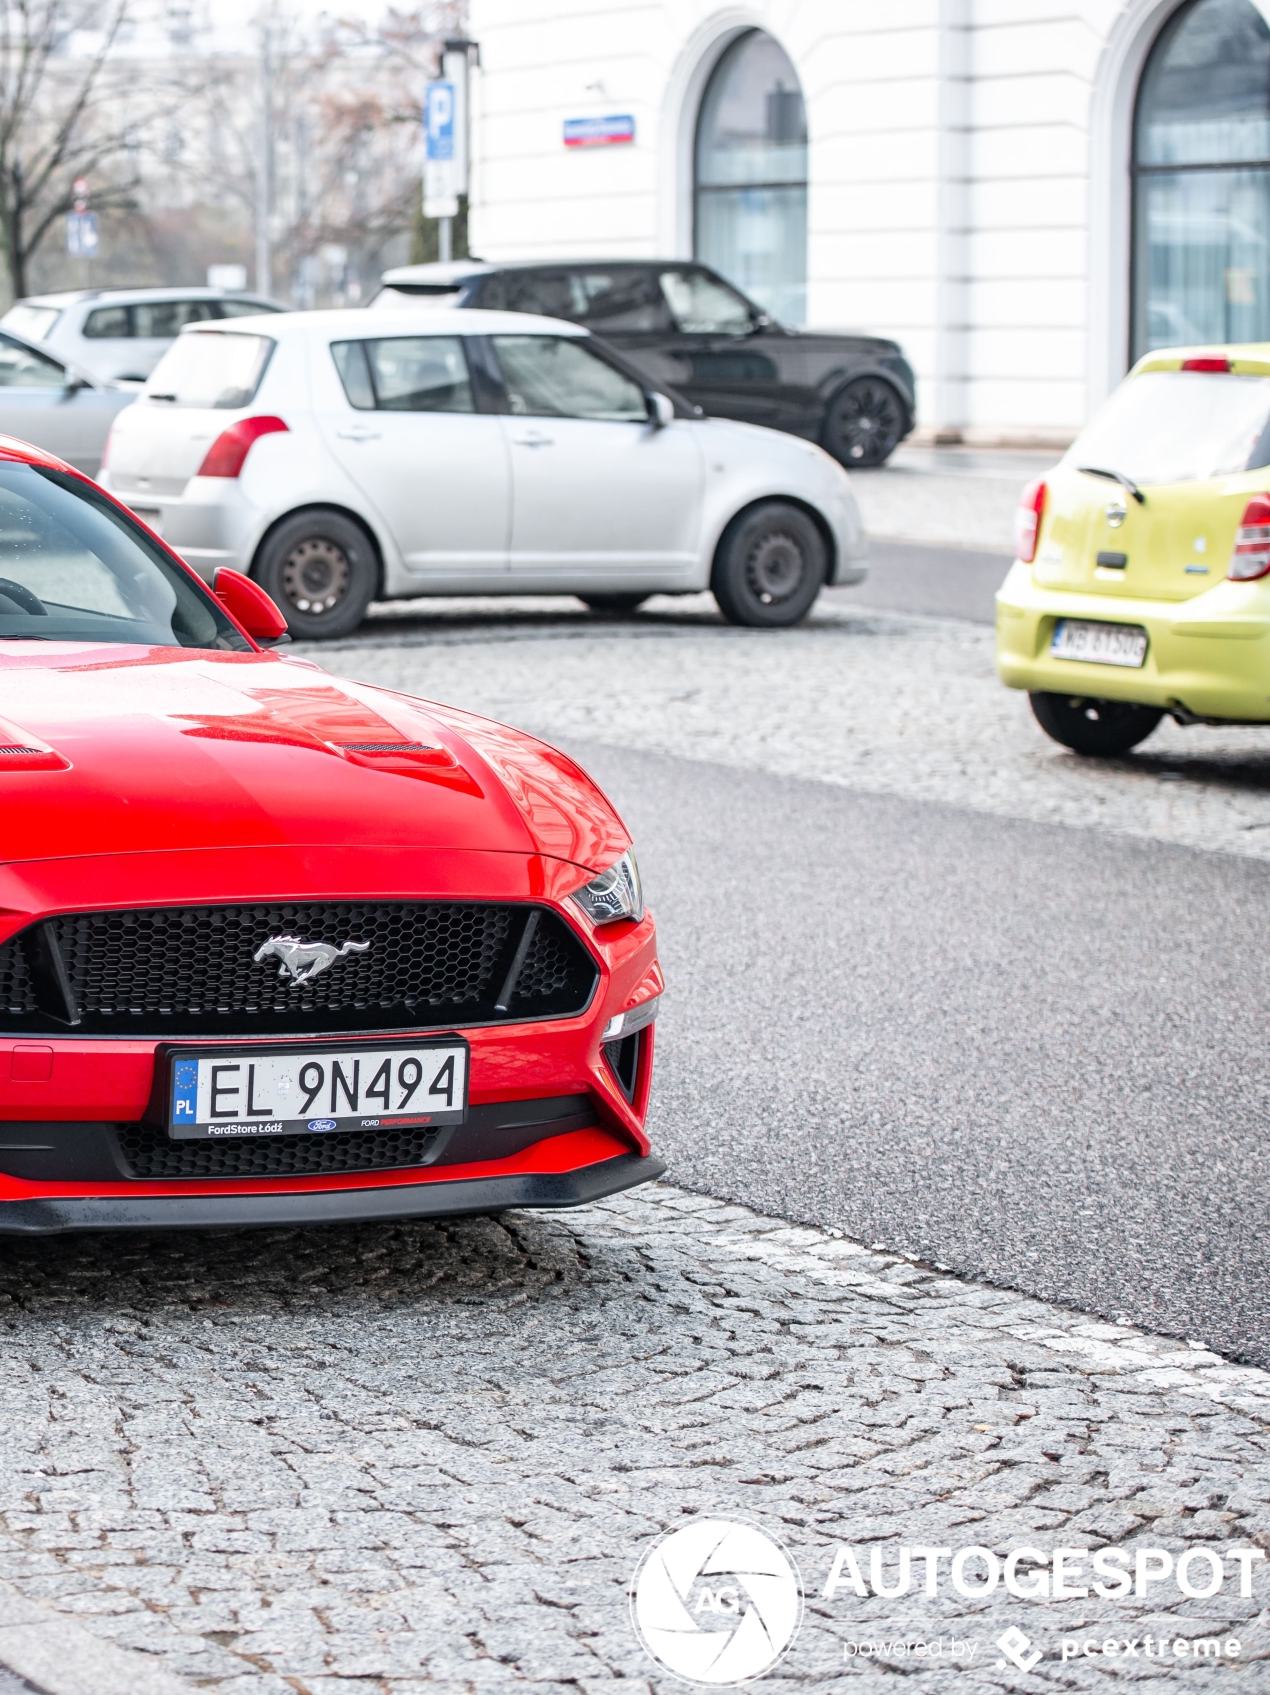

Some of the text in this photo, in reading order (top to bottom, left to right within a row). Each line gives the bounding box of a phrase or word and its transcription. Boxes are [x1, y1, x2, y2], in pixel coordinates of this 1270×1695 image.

[210, 1055, 455, 1119] EL 9N494
[175, 1100, 194, 1115] PL
[311, 1120, 333, 1131] Ford
[361, 1116, 431, 1127] FORD PERFORMANCE
[208, 1122, 283, 1135] FordStore Łódź
